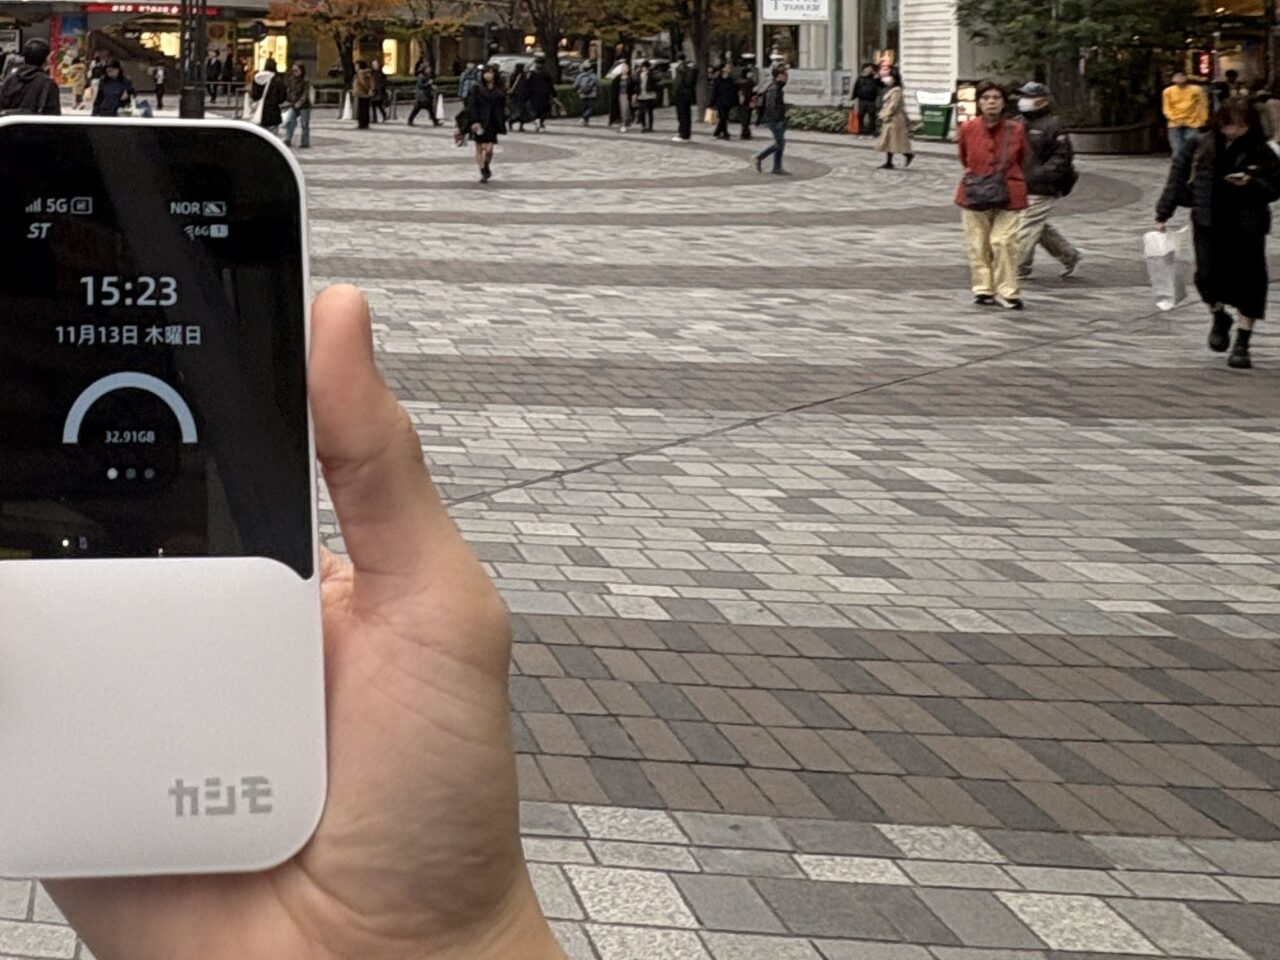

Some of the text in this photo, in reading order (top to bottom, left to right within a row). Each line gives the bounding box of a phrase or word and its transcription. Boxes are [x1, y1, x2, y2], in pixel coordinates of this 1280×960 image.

[46, 198, 68, 213] 5G
[170, 201, 201, 214] NOR
[26, 222, 52, 239] ST
[80, 276, 178, 306] 15:23
[55, 325, 202, 345] 11月13日 木曜日
[105, 430, 156, 443] 32.91GB
[168, 776, 272, 817] カシモ
